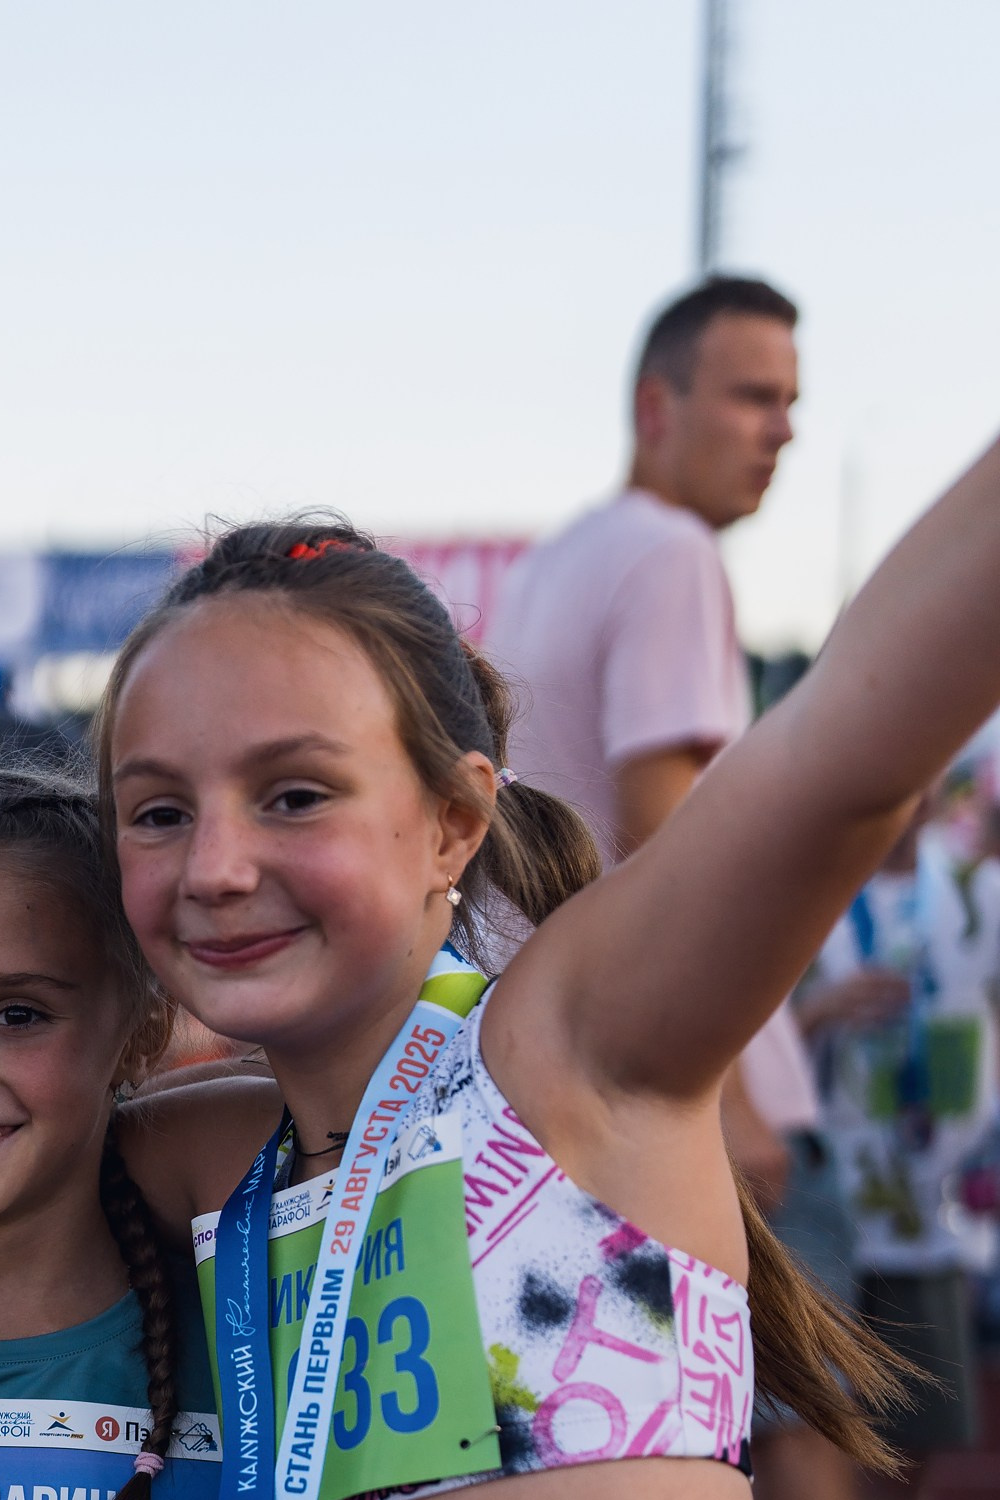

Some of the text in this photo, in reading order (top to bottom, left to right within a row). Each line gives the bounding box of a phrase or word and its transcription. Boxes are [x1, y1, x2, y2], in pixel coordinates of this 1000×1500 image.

[193, 1227, 218, 1248] СПО
[284, 1024, 446, 1494] СТАНЬ ПЕРВЫМ 29 АВГУСТА 2025
[125, 1421, 151, 1442] Пэ
[230, 1344, 258, 1492] КАЛУЖСКИЙ
[287, 1296, 440, 1451] 33
